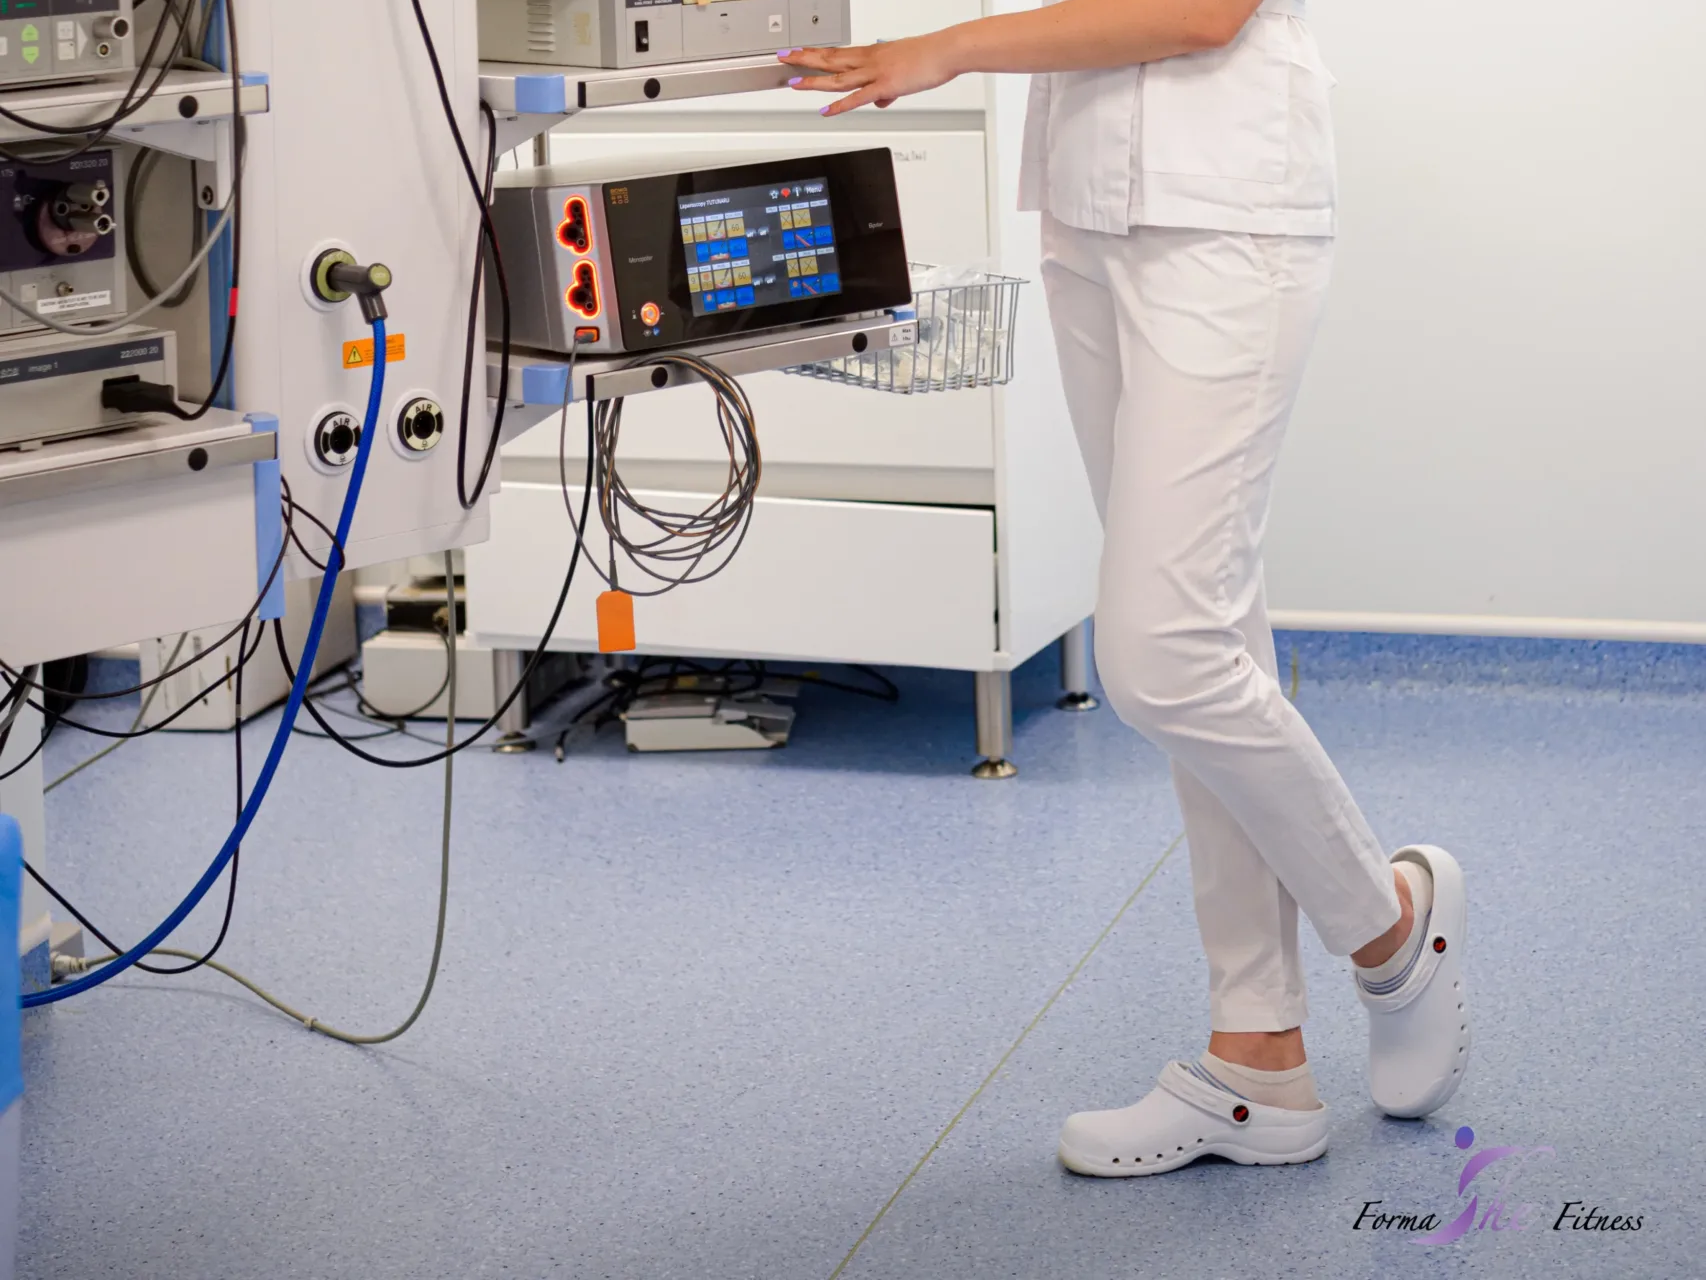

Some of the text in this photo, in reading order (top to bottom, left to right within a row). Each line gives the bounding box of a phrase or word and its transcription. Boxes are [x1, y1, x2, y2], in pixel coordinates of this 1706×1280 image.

[805, 185, 822, 195] Menu
[414, 403, 432, 413] AIR
[333, 417, 350, 428] AIR
